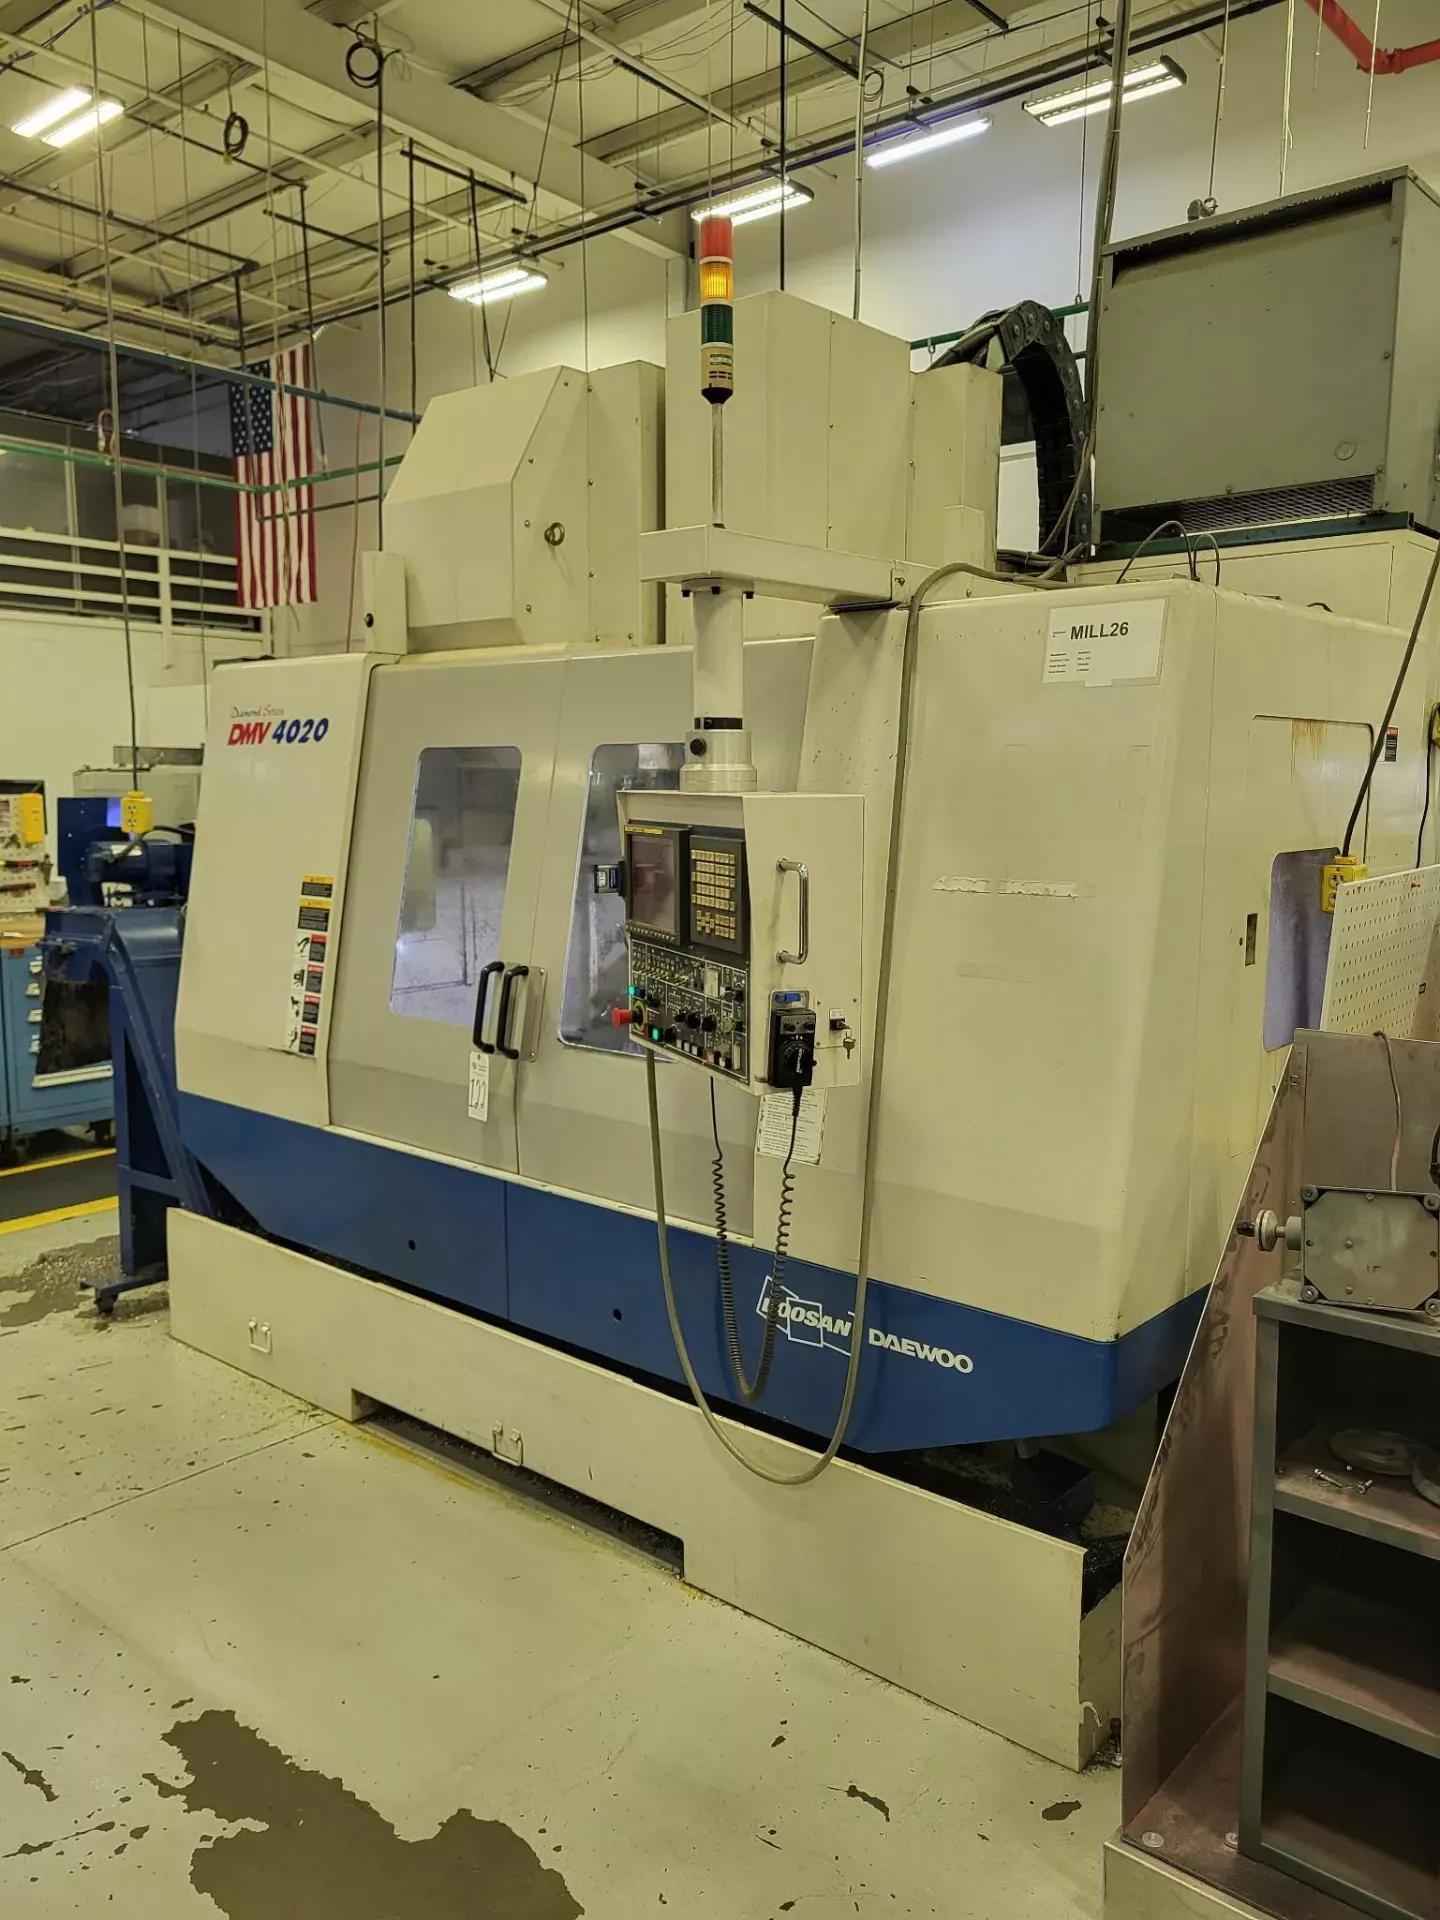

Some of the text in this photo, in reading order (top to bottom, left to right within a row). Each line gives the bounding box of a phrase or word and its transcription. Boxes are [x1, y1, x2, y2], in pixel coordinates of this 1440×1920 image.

[1070, 621, 1129, 640] MILL26
[227, 718, 329, 746] DMV 4020
[869, 1328, 974, 1374] DAEWOO
